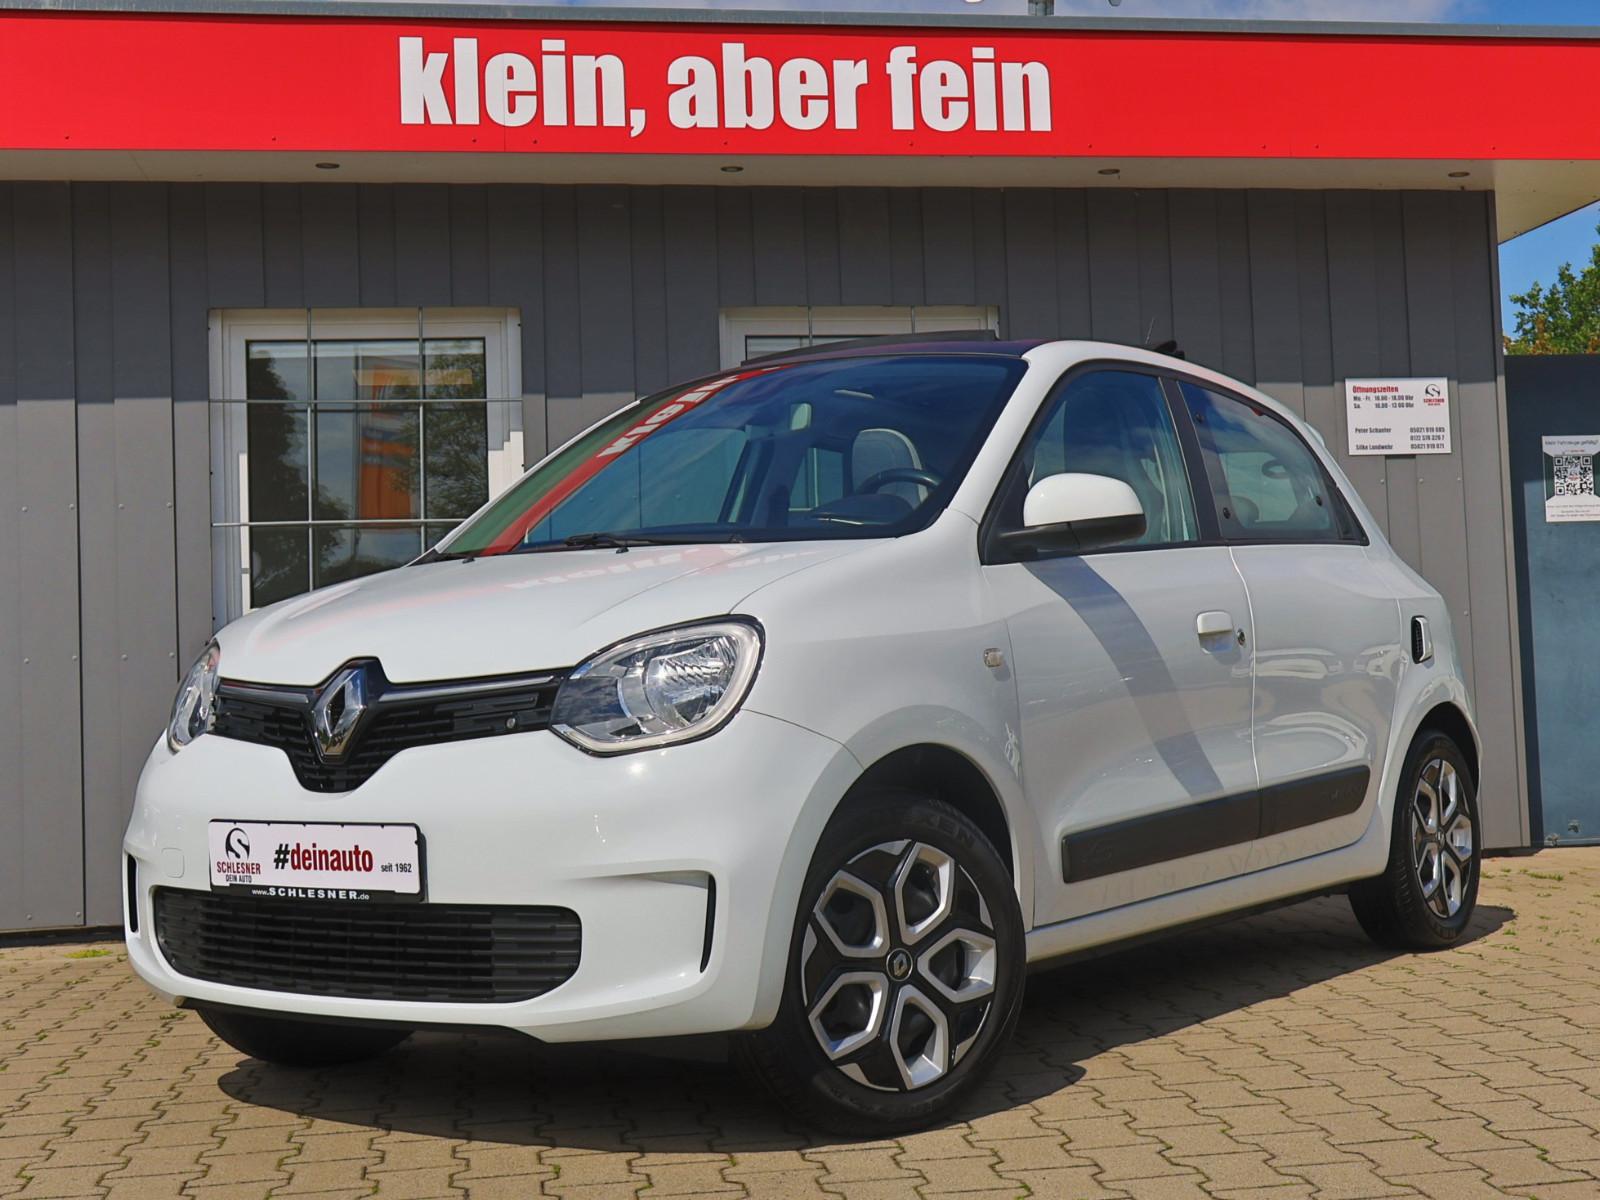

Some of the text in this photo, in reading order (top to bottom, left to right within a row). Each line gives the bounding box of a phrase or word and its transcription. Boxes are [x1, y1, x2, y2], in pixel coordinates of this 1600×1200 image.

[400, 36, 1052, 138] klein, aber fein
[273, 842, 374, 872] #deinauto
[216, 861, 261, 875] SCHLESNER
[381, 863, 412, 873] seit 1962
[225, 874, 252, 884] DEIN AUTO
[251, 887, 370, 901] www.SCHLESNER.de
